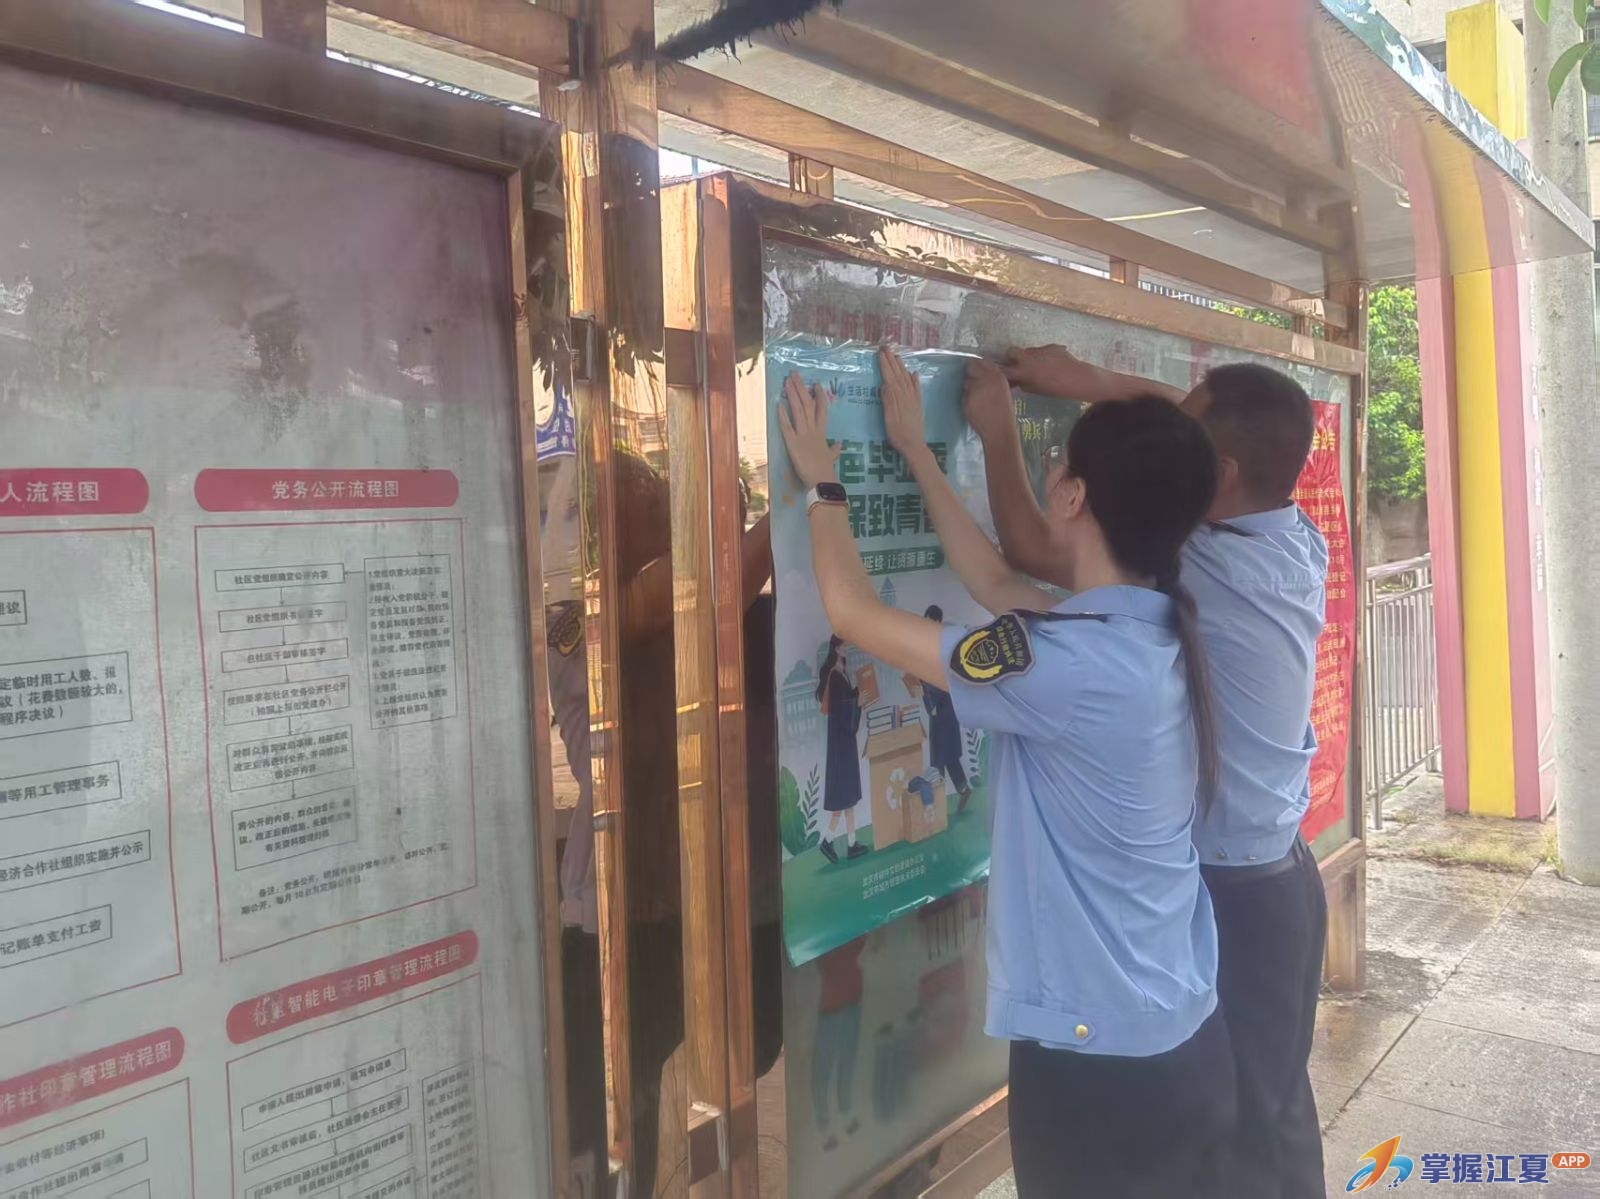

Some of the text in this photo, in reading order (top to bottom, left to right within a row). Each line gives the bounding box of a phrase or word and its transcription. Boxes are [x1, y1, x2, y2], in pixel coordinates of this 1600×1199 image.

[3, 481, 100, 503] 人流程图
[271, 479, 400, 500] 党务公开流程图
